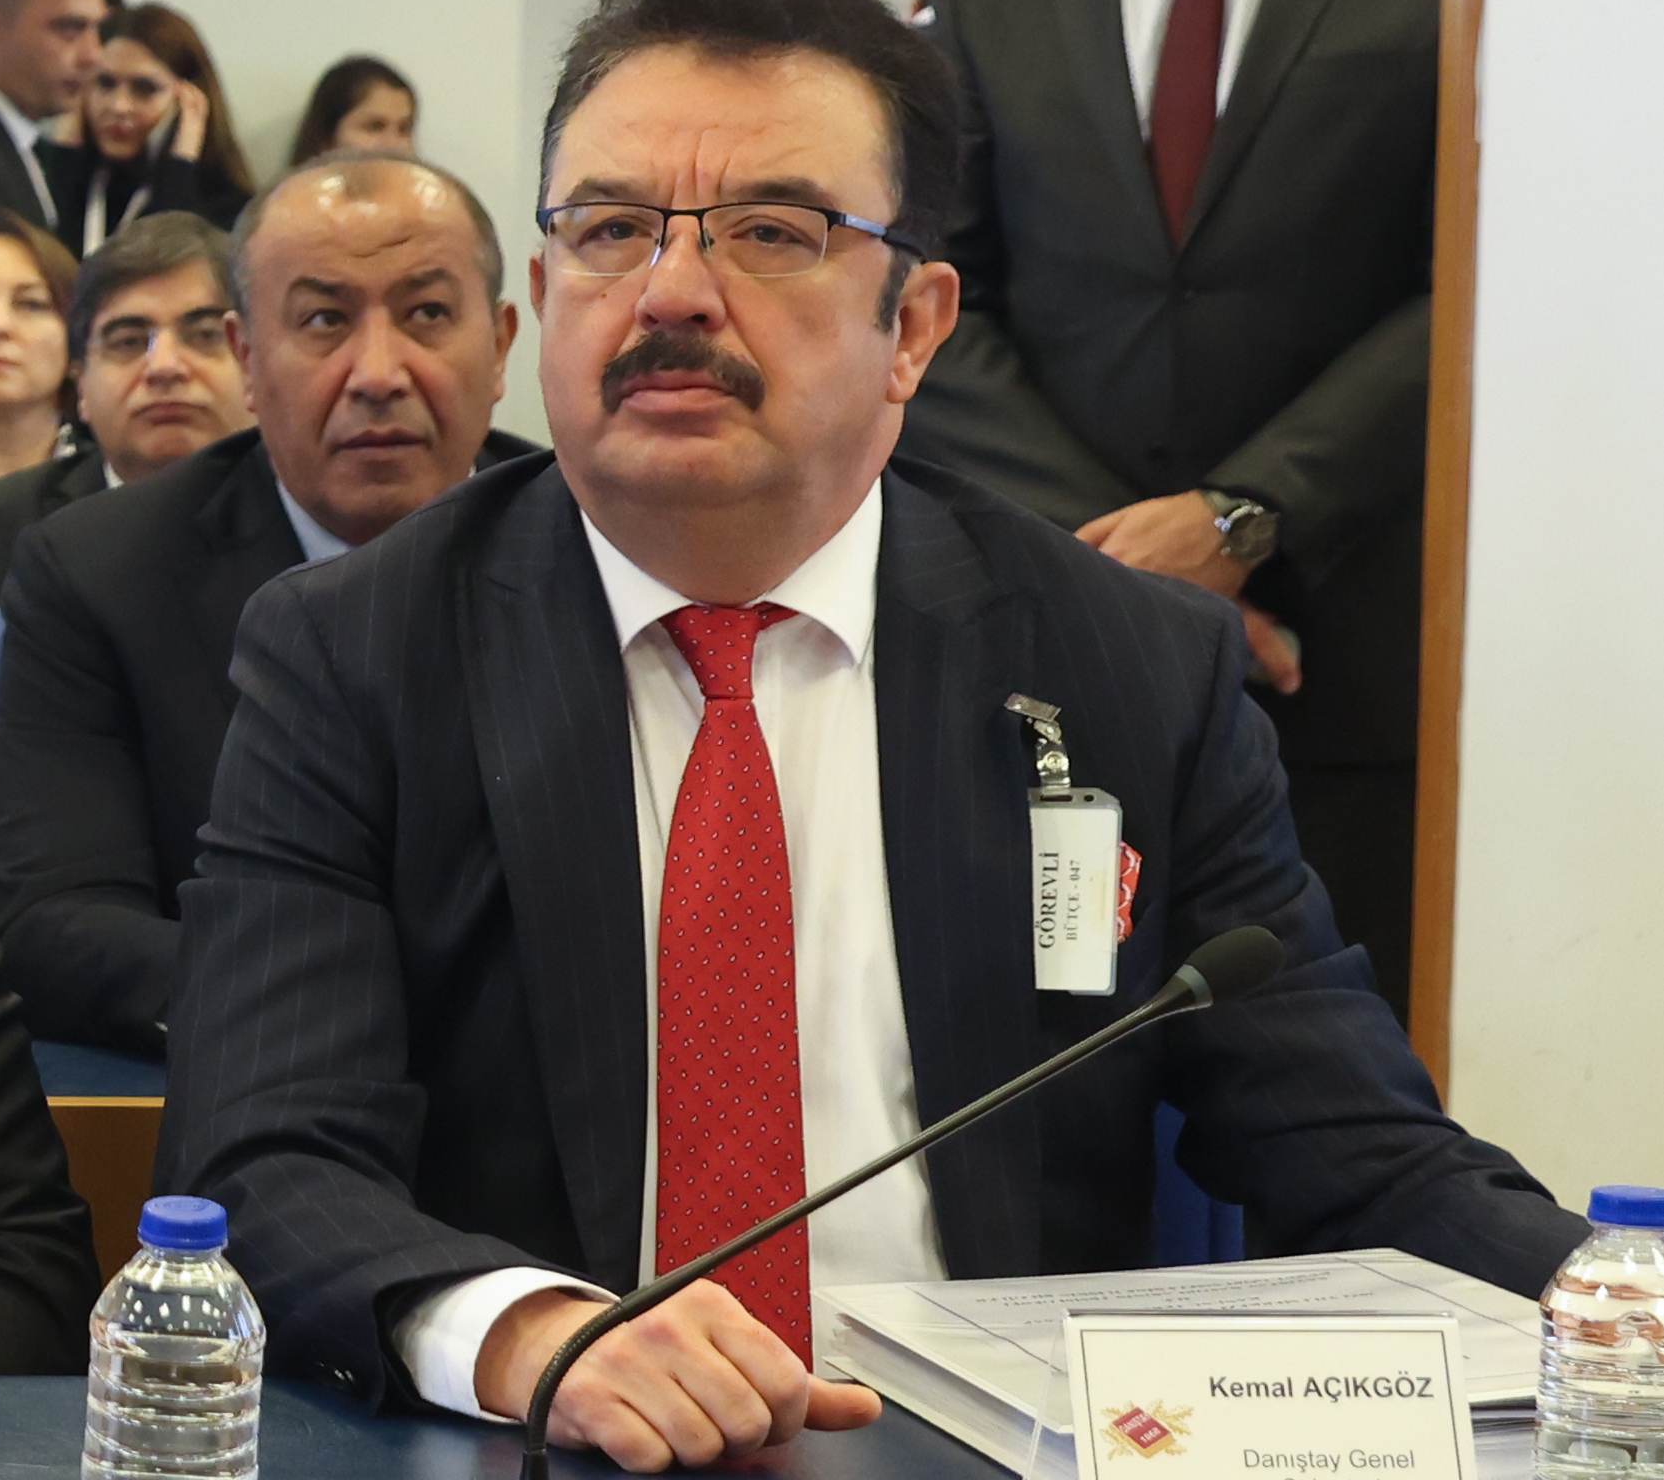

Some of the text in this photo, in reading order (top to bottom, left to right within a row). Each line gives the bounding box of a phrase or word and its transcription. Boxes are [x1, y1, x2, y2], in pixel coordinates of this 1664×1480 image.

[1068, 860, 1081, 881] 047
[1034, 851, 1060, 949] GÖREVLİ
[1063, 893, 1081, 941] BÜTÇE
[1209, 1371, 1435, 1403] Kemal AÇIKGÖZ
[1243, 1449, 1416, 1473] Danıştay Genel
